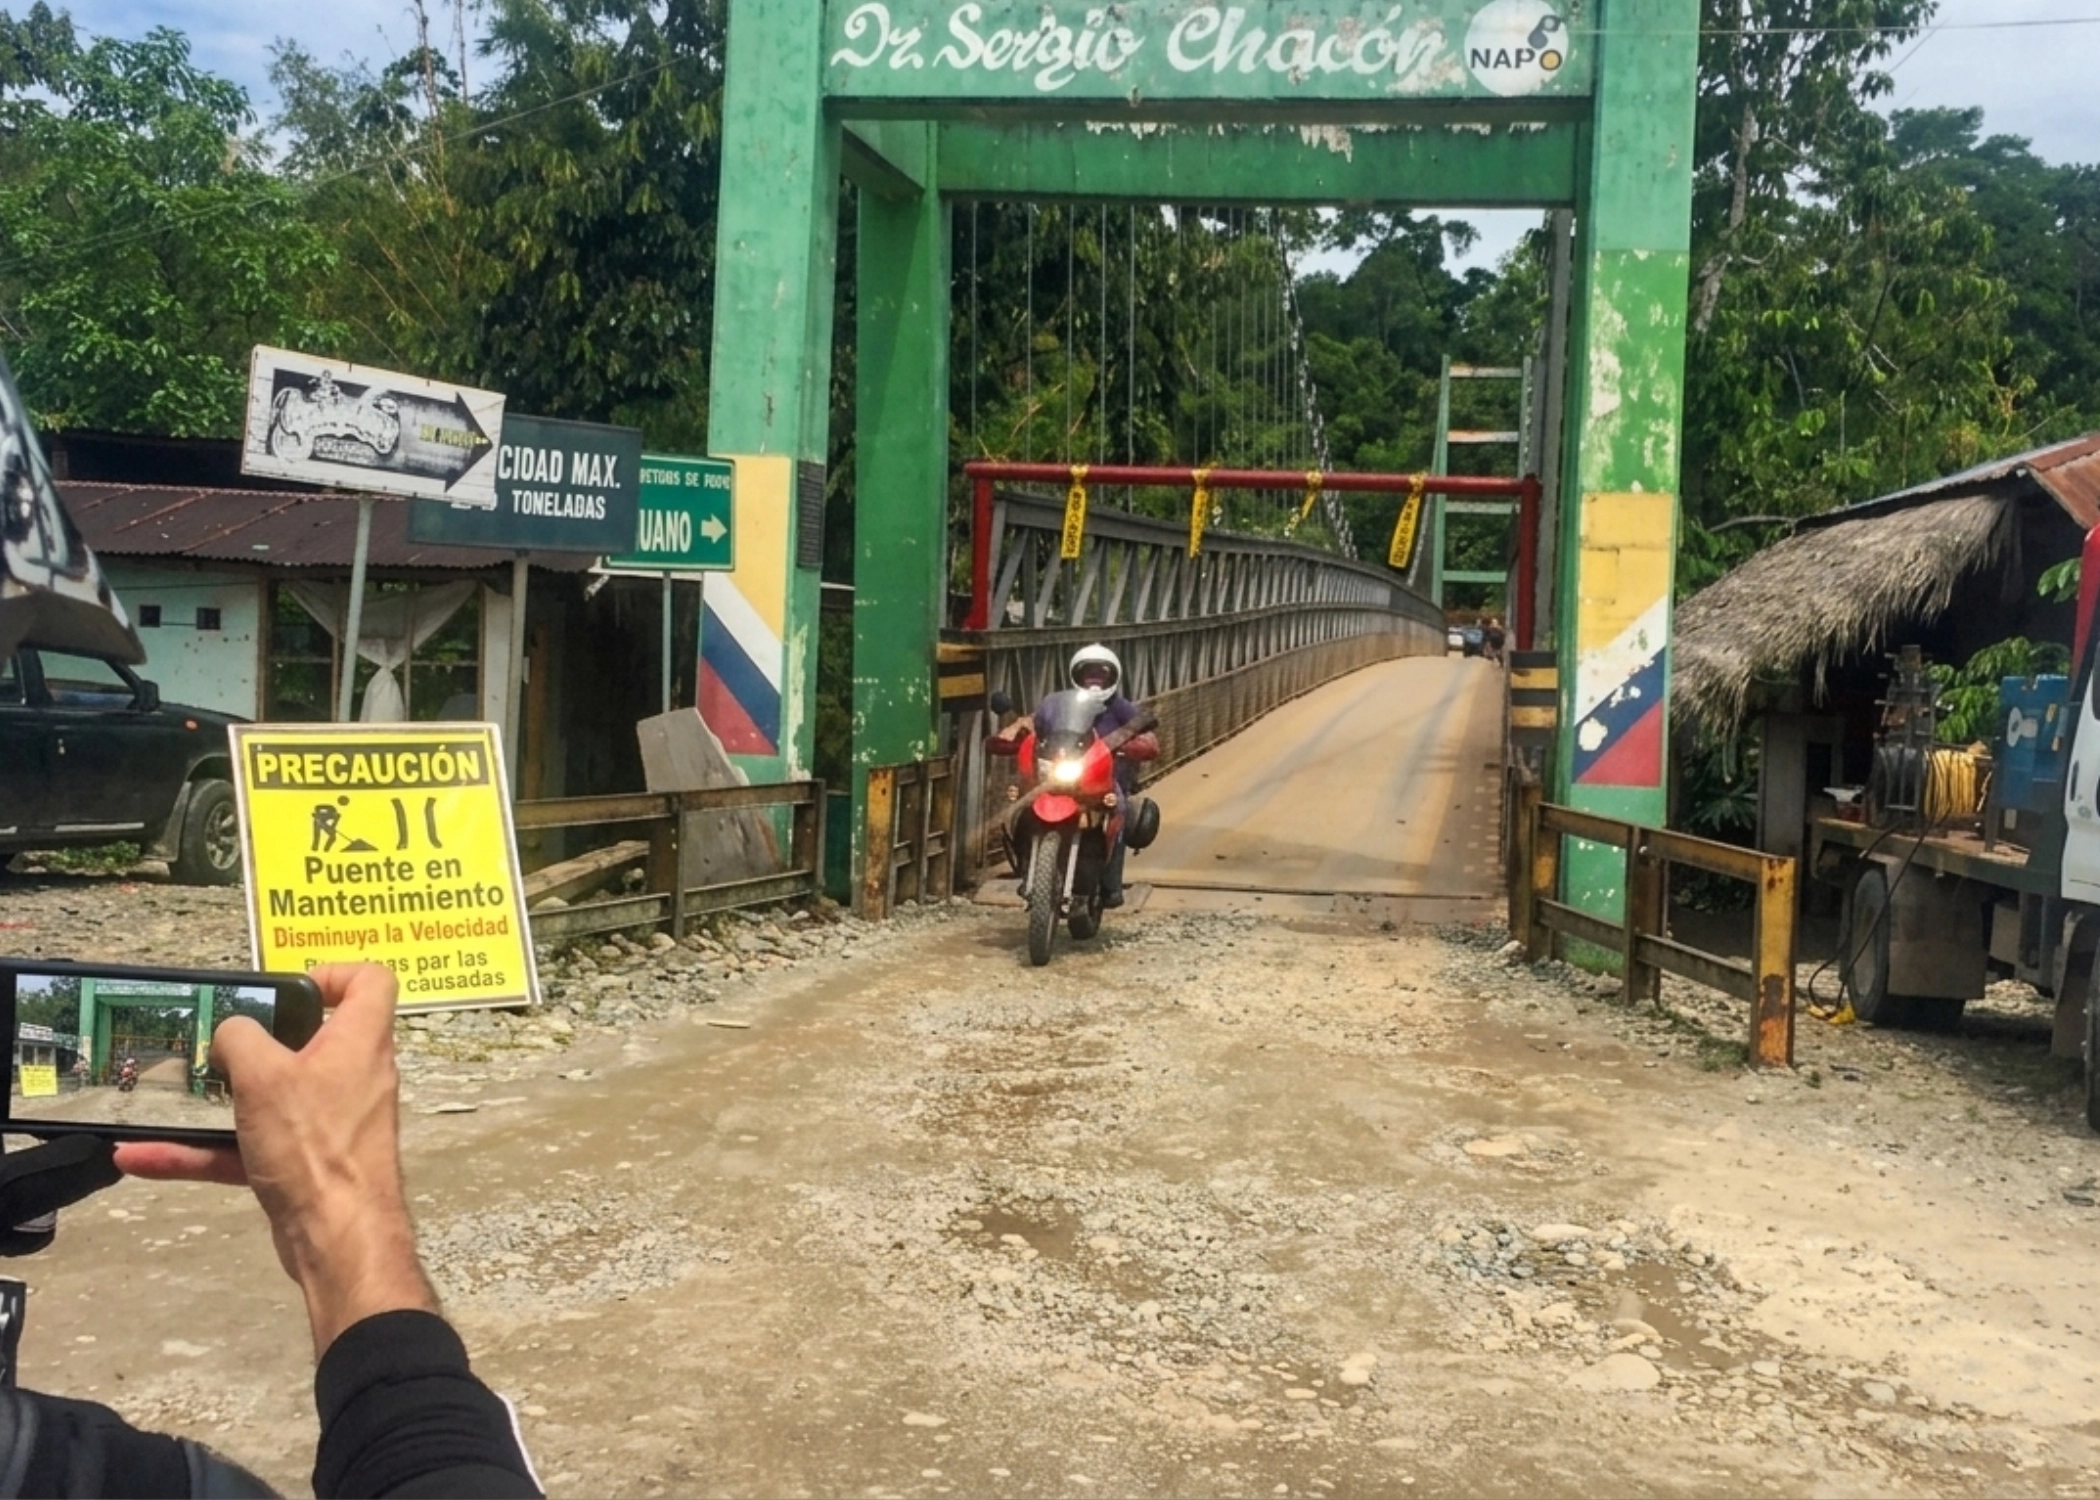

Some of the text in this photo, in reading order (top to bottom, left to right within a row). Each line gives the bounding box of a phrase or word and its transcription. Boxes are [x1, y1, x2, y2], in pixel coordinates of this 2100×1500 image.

[932, 2, 1145, 92] Sergio
[1166, 4, 1448, 76] Chacón
[571, 451, 621, 489] MAX.
[635, 509, 693, 553] UANO
[257, 746, 480, 784] PRECAUCIÓN
[304, 857, 462, 884] Puente en
[269, 883, 505, 918] Mantenimiento
[273, 926, 380, 951] Disminuya
[386, 923, 404, 943] la
[458, 950, 488, 968] las
[406, 970, 506, 993] causadas
